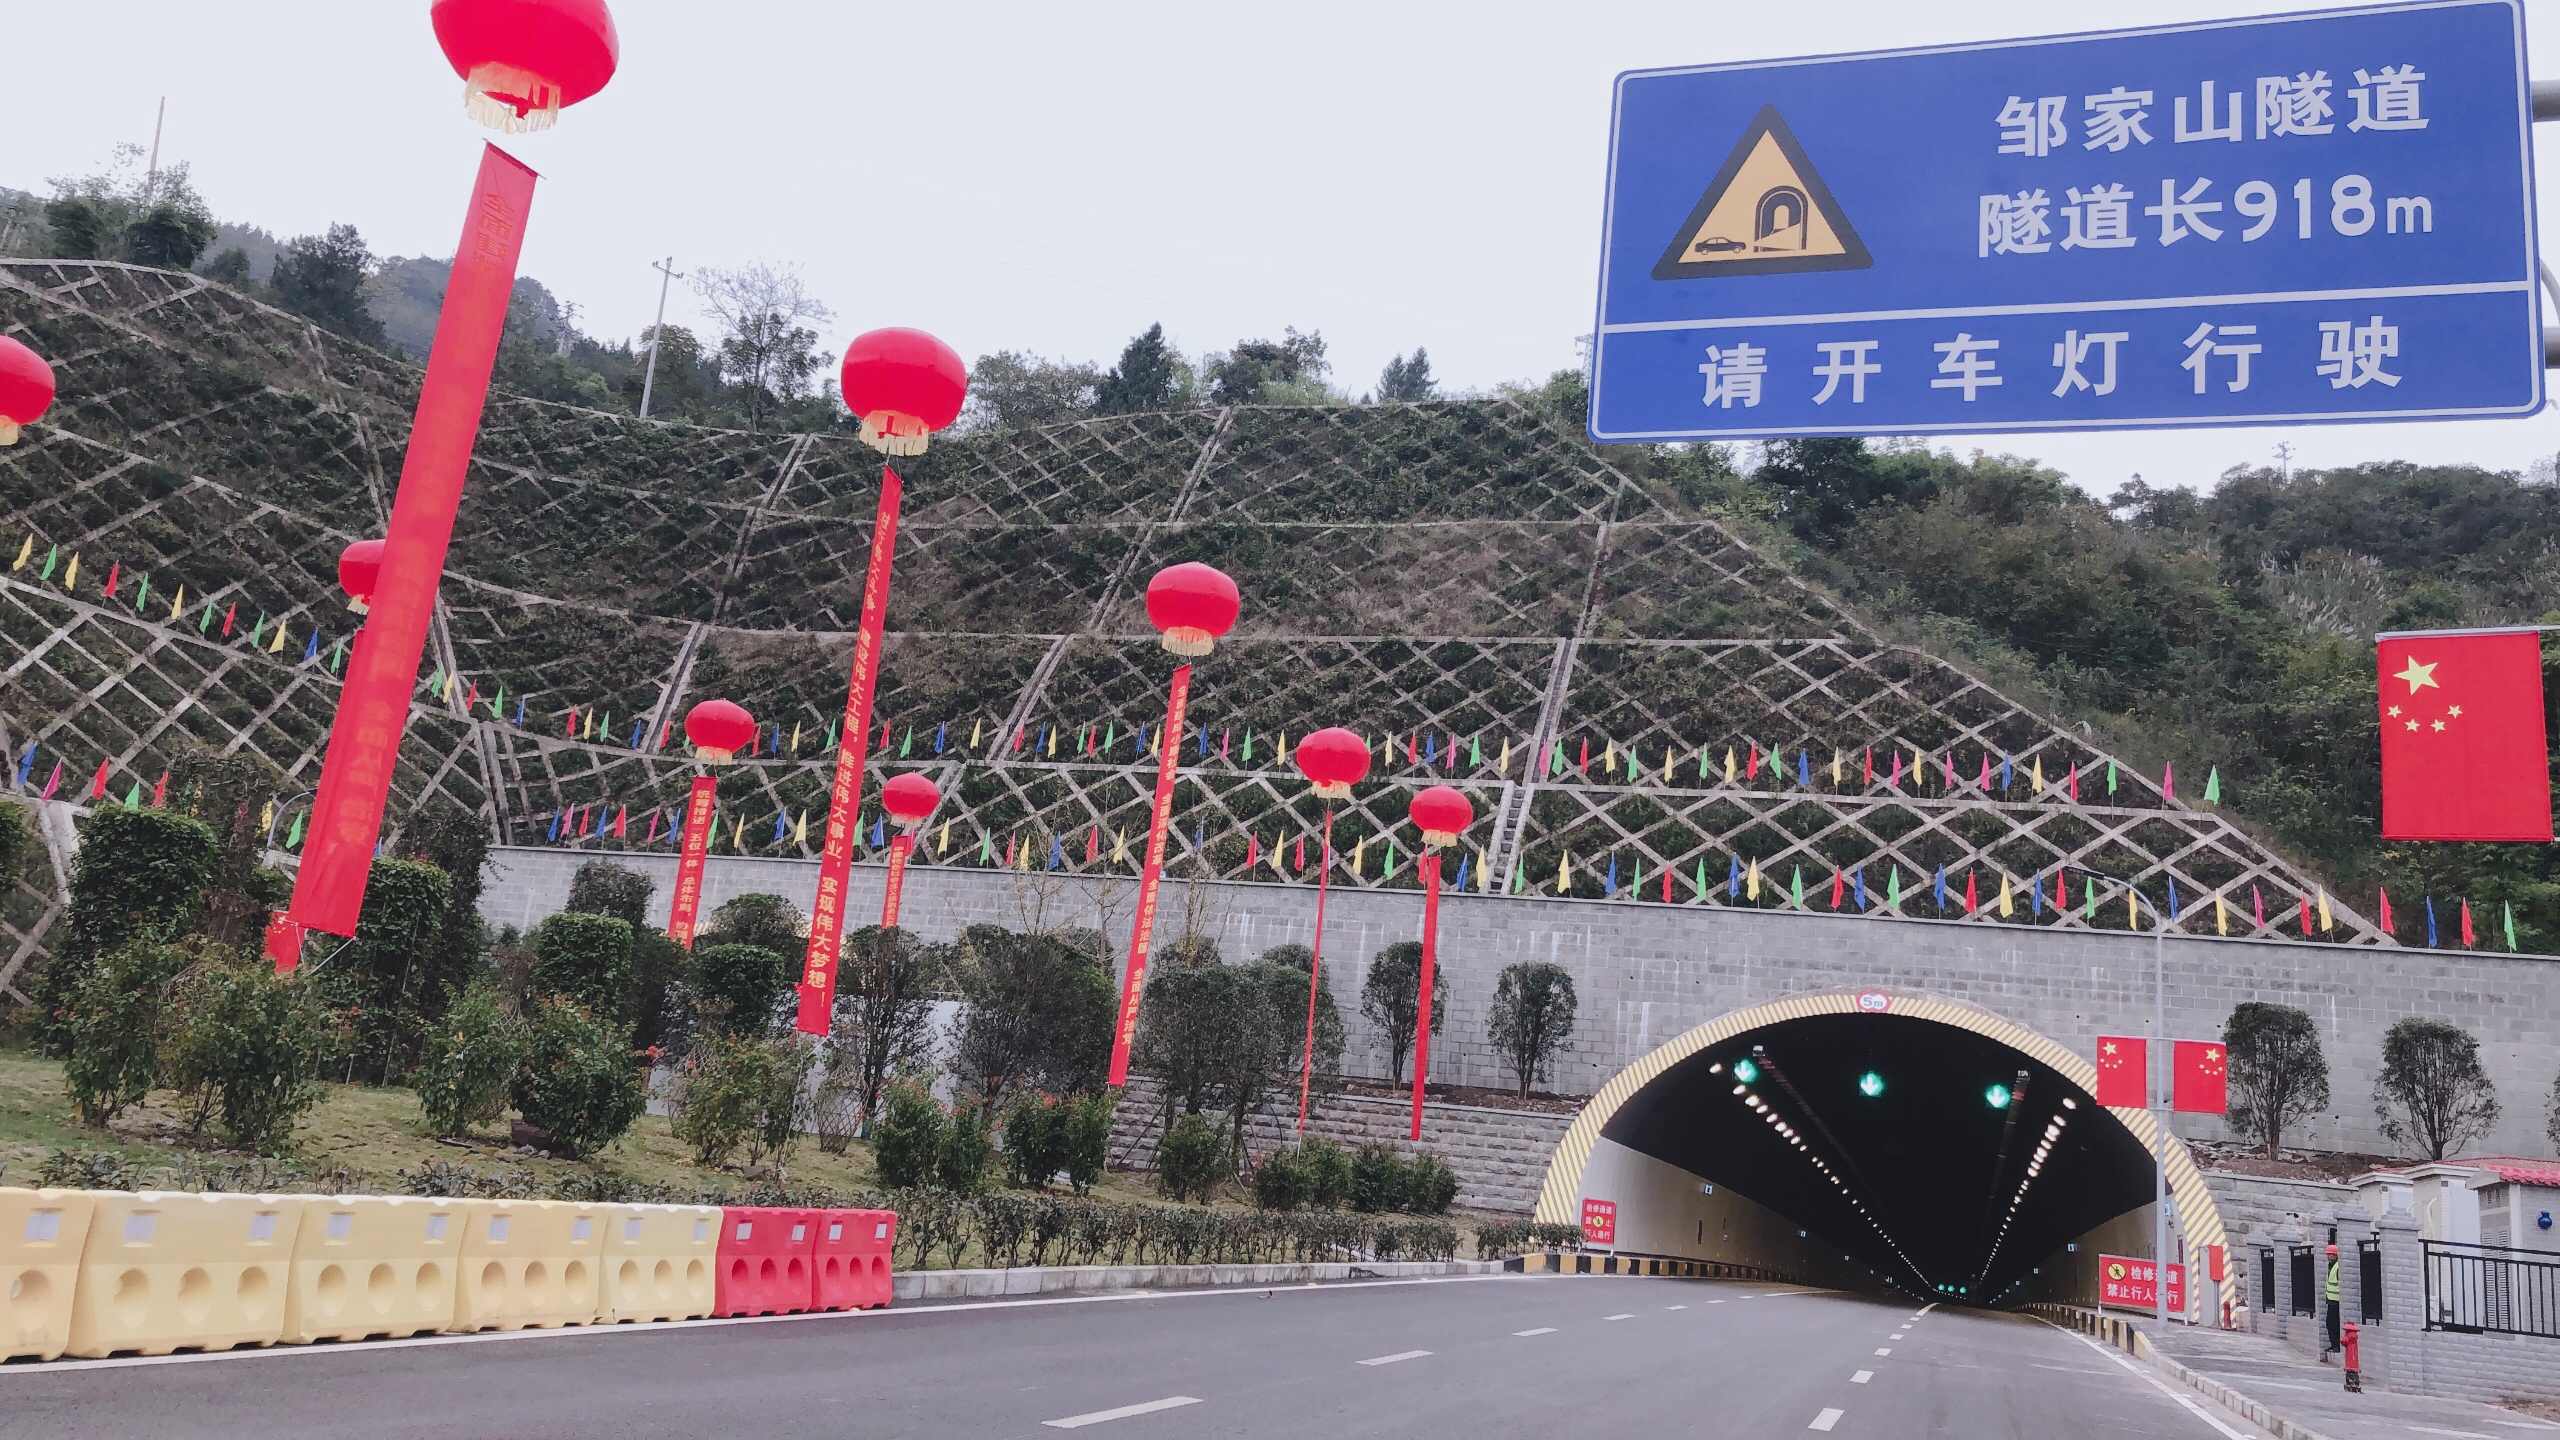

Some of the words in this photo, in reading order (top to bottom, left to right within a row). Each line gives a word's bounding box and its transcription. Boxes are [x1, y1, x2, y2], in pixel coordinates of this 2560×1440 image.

[1995, 63, 2430, 158] 邹家山隧道
[1978, 175, 2433, 258] 隧道长918m
[1698, 316, 2403, 409] 请开车灯行驶
[2107, 1282, 2179, 1305] 禁止行人行
[2131, 1265, 2178, 1285] 检修道
